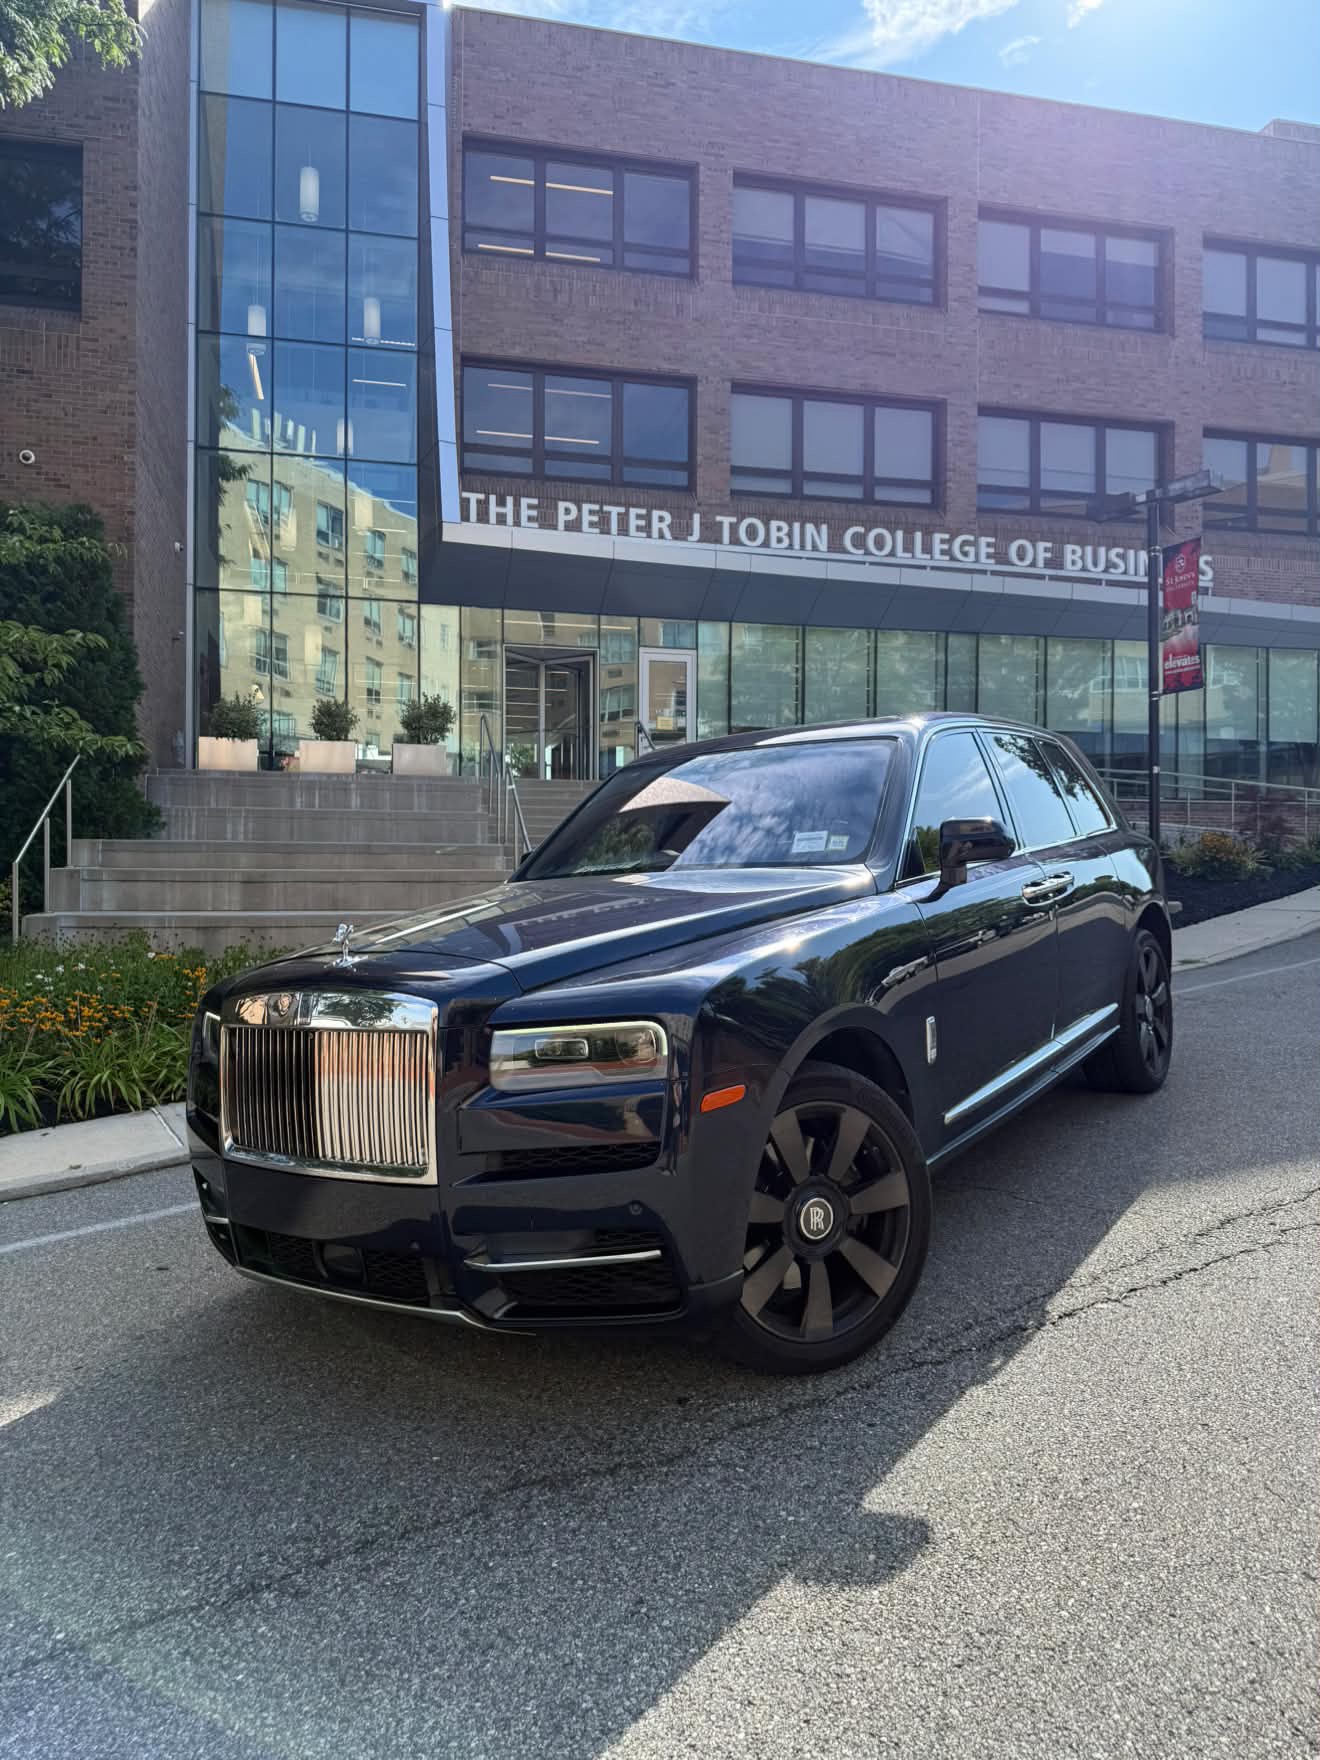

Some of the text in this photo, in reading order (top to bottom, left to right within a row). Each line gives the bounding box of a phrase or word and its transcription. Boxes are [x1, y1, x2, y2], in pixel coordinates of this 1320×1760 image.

[461, 491, 1214, 581] THE PETER J TOBIN COLLEGE OF BUSINS
[1164, 653, 1200, 670] elevates
